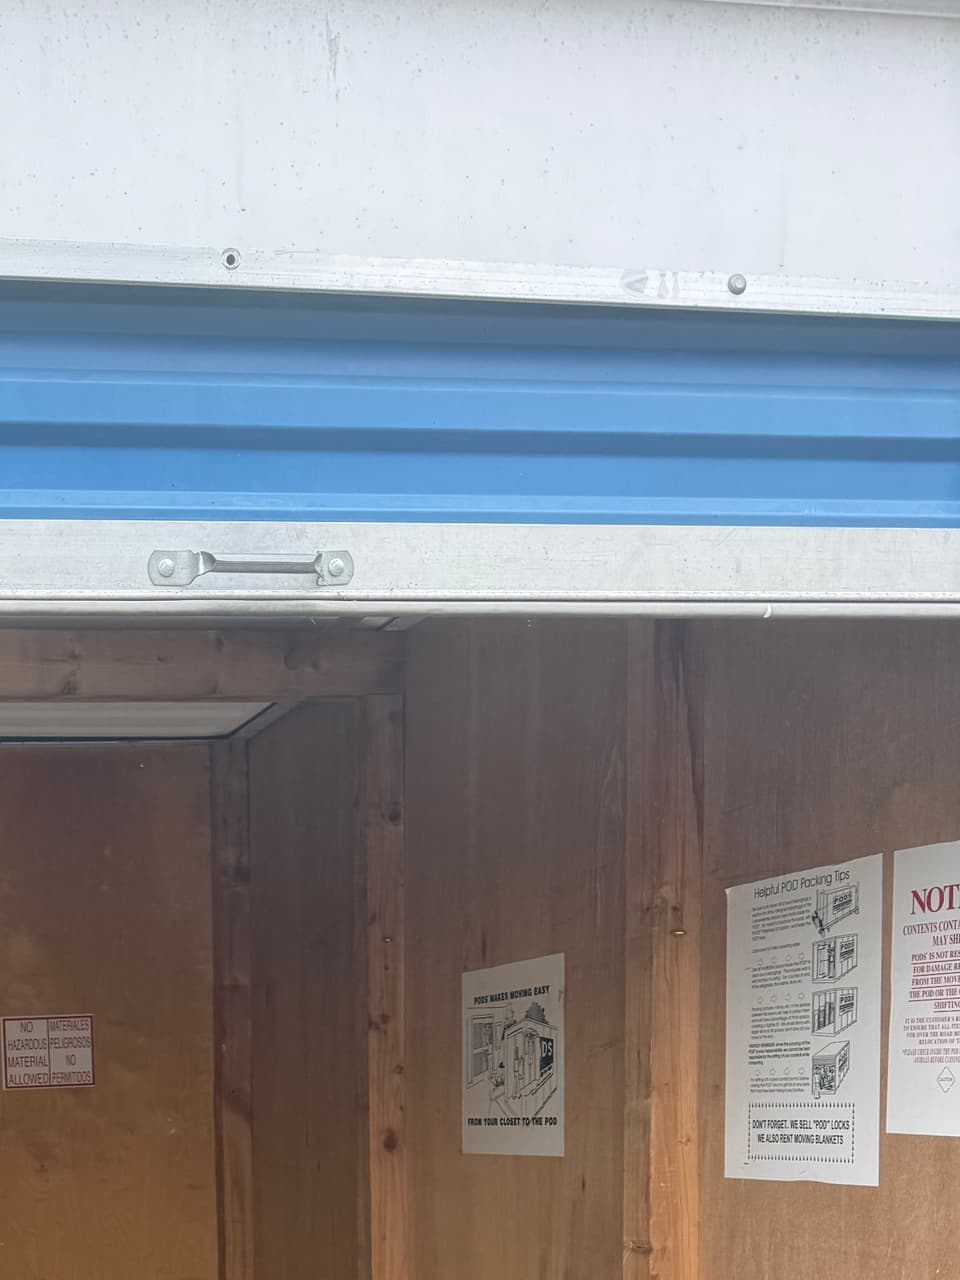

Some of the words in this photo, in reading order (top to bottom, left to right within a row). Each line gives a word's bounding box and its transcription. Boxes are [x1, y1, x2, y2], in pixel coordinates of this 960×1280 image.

[754, 883, 780, 899] Helpful
[782, 879, 798, 893] POD
[800, 873, 832, 889] Packing
[834, 870, 850, 883] Tips
[910, 883, 960, 915] NOT
[903, 922, 937, 936] CONTENTS
[933, 935, 948, 946] MAY
[936, 951, 948, 960] NOT
[913, 965, 925, 974] FOR
[926, 963, 952, 973] DAMAGE
[912, 977, 929, 986] FROM
[930, 976, 942, 985] THE
[490, 992, 508, 1003] MAKES
[510, 987, 532, 999] MOVING
[534, 985, 550, 996] EASY
[922, 989, 934, 998] POD
[20, 1021, 34, 1033] NO
[49, 1019, 89, 1032] MATERIALES
[7, 1038, 48, 1051] HAZARDOUS
[49, 1036, 91, 1049] PELIGROSOS
[8, 1055, 48, 1068] MATERIAL
[65, 1054, 76, 1066] NO
[8, 1073, 49, 1085] ALLOWED
[51, 1071, 91, 1083] PERMITIDOS
[500, 1117, 520, 1126] CLOSET
[522, 1117, 530, 1126] TO
[531, 1117, 543, 1126] THE
[544, 1117, 558, 1126] POD
[790, 1120, 798, 1129] WE
[800, 1120, 812, 1130] SELL
[832, 1120, 850, 1130] LOCKS
[757, 1134, 765, 1143] WE
[766, 1134, 779, 1143] ALSO
[780, 1134, 793, 1143] RENT
[794, 1134, 814, 1143] MOVING
[816, 1134, 844, 1144] BLANKETS
